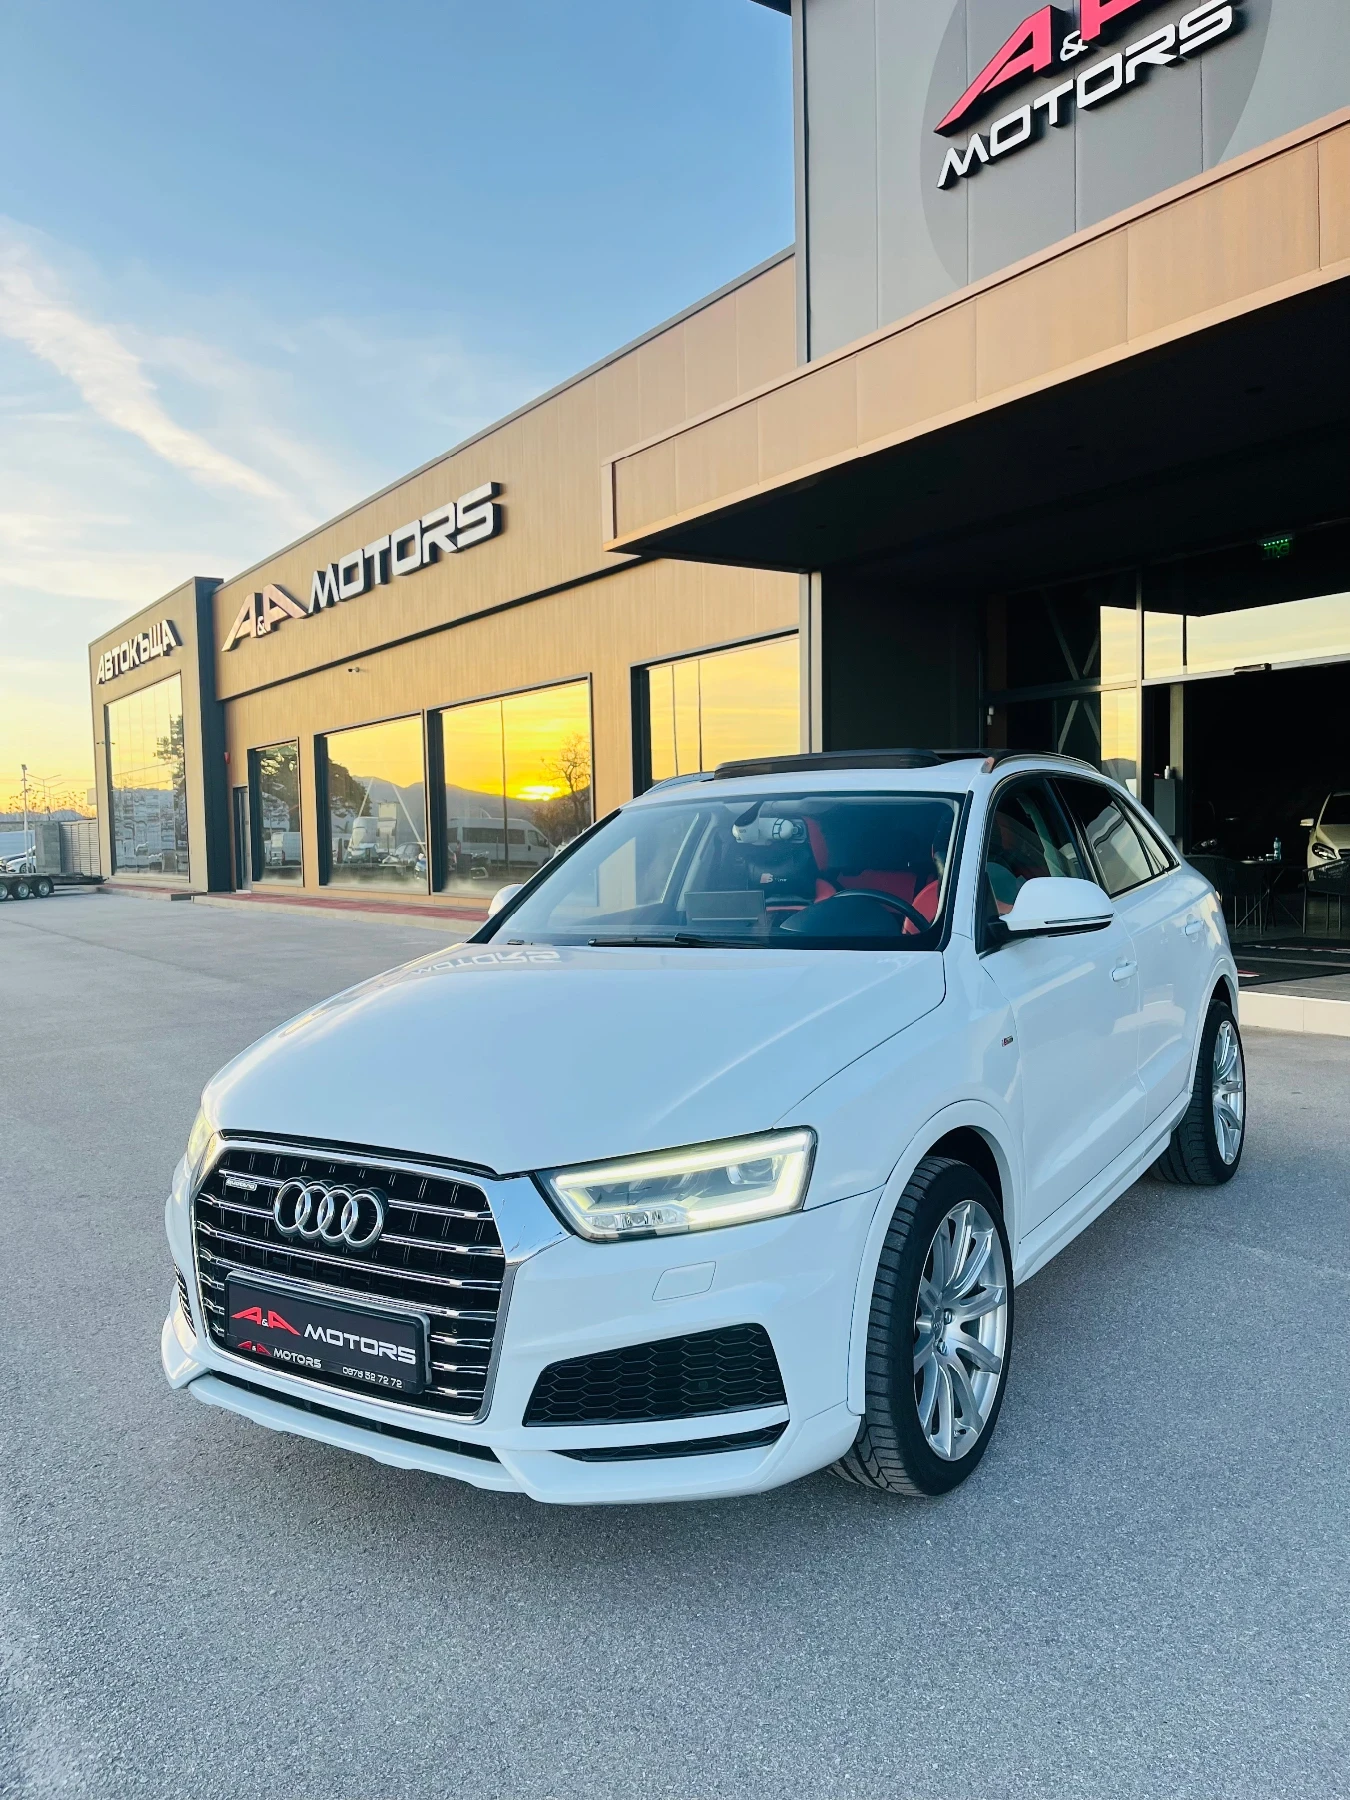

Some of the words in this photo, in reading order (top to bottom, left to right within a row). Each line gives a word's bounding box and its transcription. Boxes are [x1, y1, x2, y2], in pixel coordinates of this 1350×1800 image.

[936, 0, 1233, 189] MOTORS
[221, 583, 309, 652] A&A
[308, 481, 498, 614] MOTORS
[96, 619, 178, 685] АВТОКЪЩА
[230, 1306, 301, 1336] A&A
[304, 1323, 416, 1365] MOTORS
[273, 1347, 322, 1369] MOTORS
[377, 1374, 389, 1385] 72
[391, 1377, 403, 1389] 72
